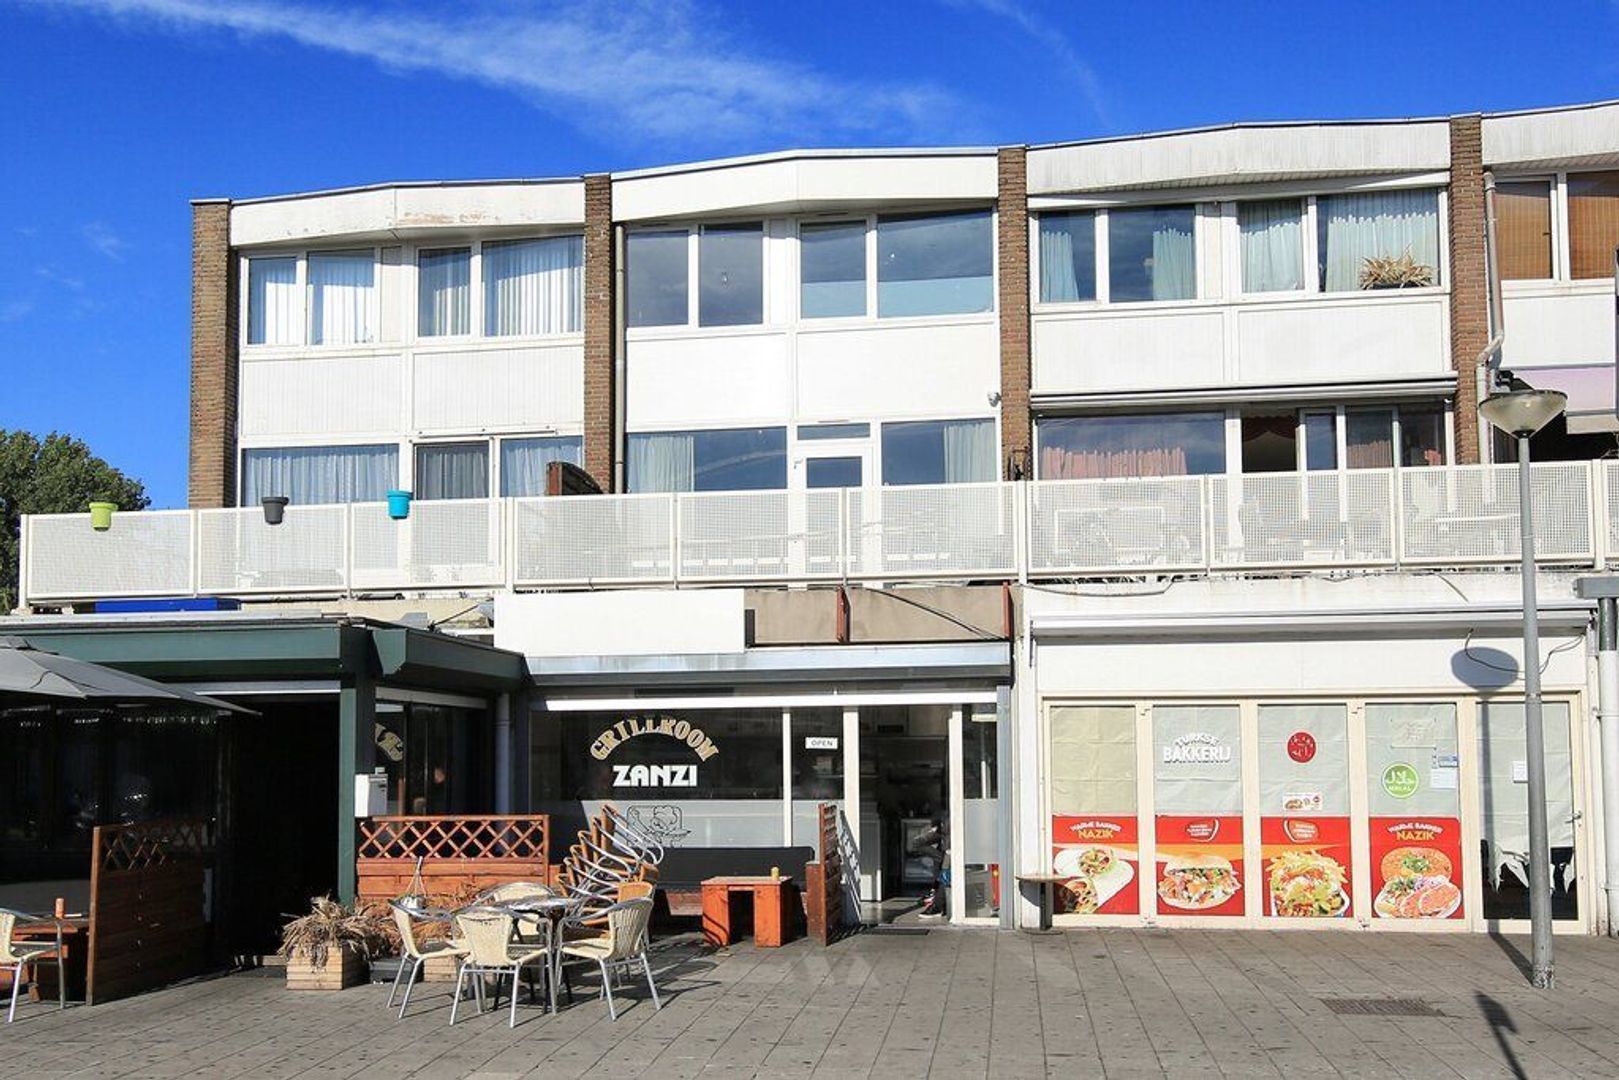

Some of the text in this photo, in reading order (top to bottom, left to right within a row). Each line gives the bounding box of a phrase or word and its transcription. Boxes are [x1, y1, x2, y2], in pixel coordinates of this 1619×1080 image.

[589, 718, 719, 762] GRILLROOM
[811, 739, 834, 747] OPEN
[612, 764, 698, 787] ZANZI
[1078, 828, 1114, 839] NAZIK
[1396, 830, 1436, 841] NAZIK
